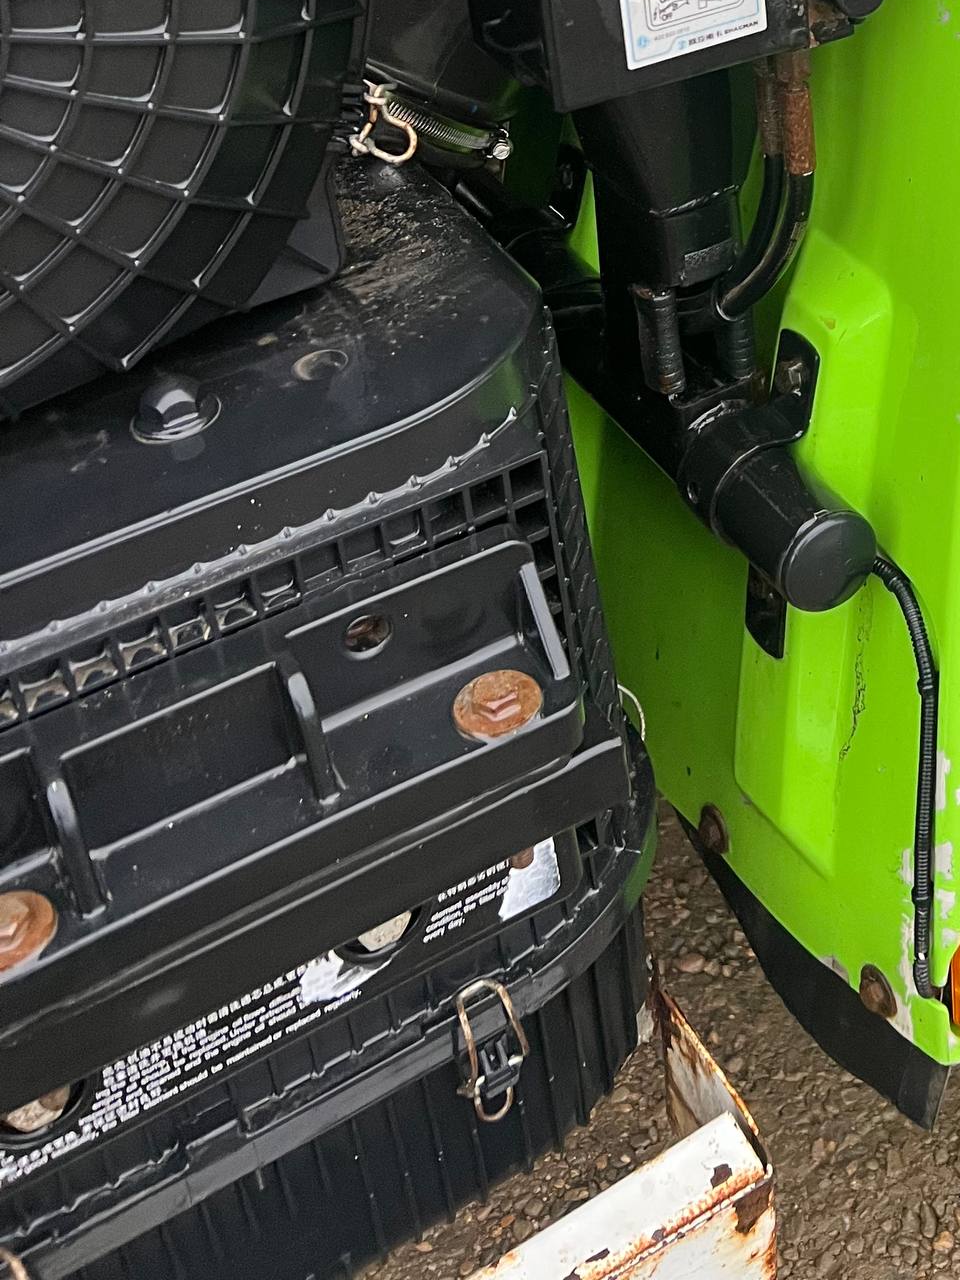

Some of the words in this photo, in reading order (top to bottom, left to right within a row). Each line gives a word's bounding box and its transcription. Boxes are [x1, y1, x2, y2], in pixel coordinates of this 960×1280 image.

[661, 12, 673, 21] OFF
[183, 1054, 202, 1071] and
[204, 1045, 219, 1060] the
[222, 1031, 251, 1051] engine
[255, 1020, 265, 1034] oil
[268, 1006, 296, 1026] should
[423, 926, 445, 943] every
[198, 1026, 229, 1046] engine
[232, 1017, 243, 1028] oil
[431, 900, 462, 922] element
[465, 881, 501, 907] assembly
[230, 1016, 256, 1038] Under
[259, 997, 293, 1023] extreme
[464, 901, 476, 913] the
[479, 890, 495, 905] filter
[179, 1070, 208, 1091] should
[211, 1063, 223, 1074] be
[226, 1035, 272, 1066] maintained
[273, 1030, 282, 1040] or
[286, 1008, 321, 1034] replaced
